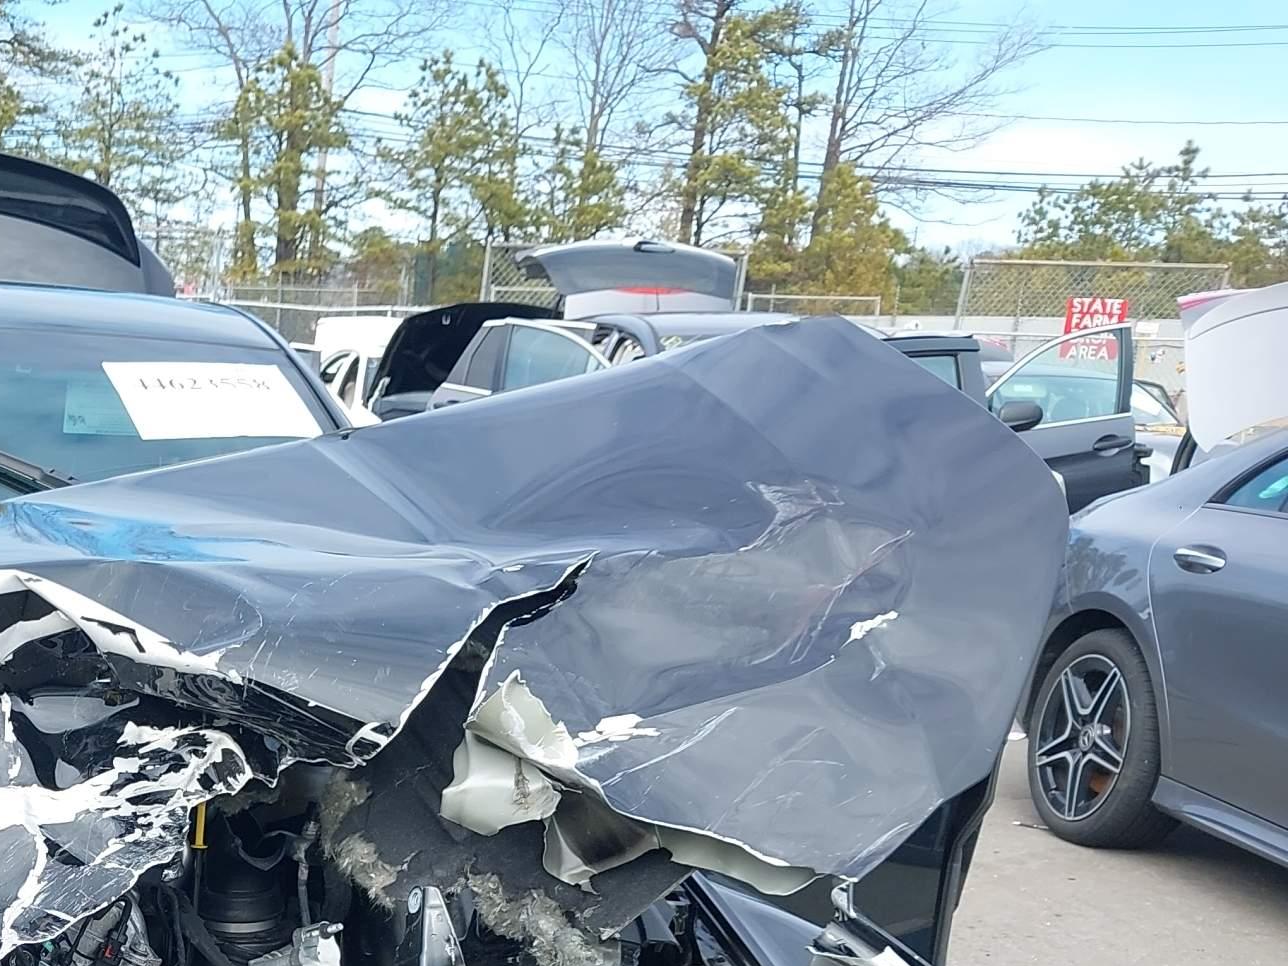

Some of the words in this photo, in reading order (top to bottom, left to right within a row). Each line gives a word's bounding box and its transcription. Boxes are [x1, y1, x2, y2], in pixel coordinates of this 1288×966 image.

[1071, 298, 1124, 313] STATE
[1071, 313, 1119, 328] FARM
[1065, 345, 1109, 361] AREA
